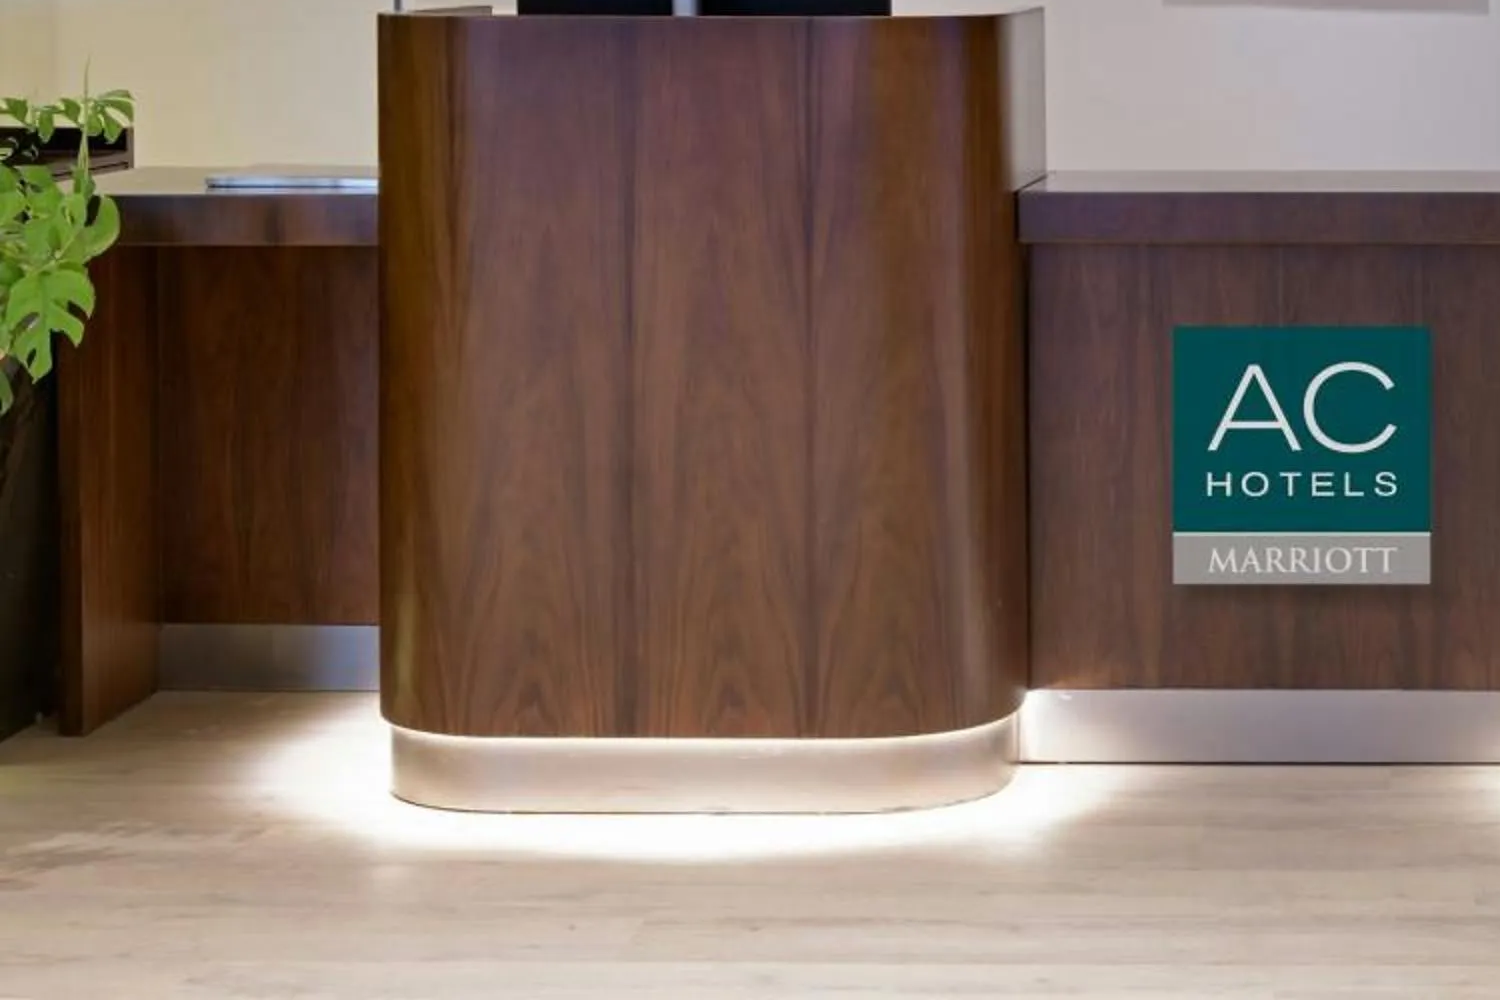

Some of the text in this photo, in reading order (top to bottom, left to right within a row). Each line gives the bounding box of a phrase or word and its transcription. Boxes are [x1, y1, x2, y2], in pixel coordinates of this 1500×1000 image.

[1207, 361, 1397, 453] AC
[1206, 471, 1397, 497] HOTELS
[1207, 547, 1398, 574] MARRIOTT
